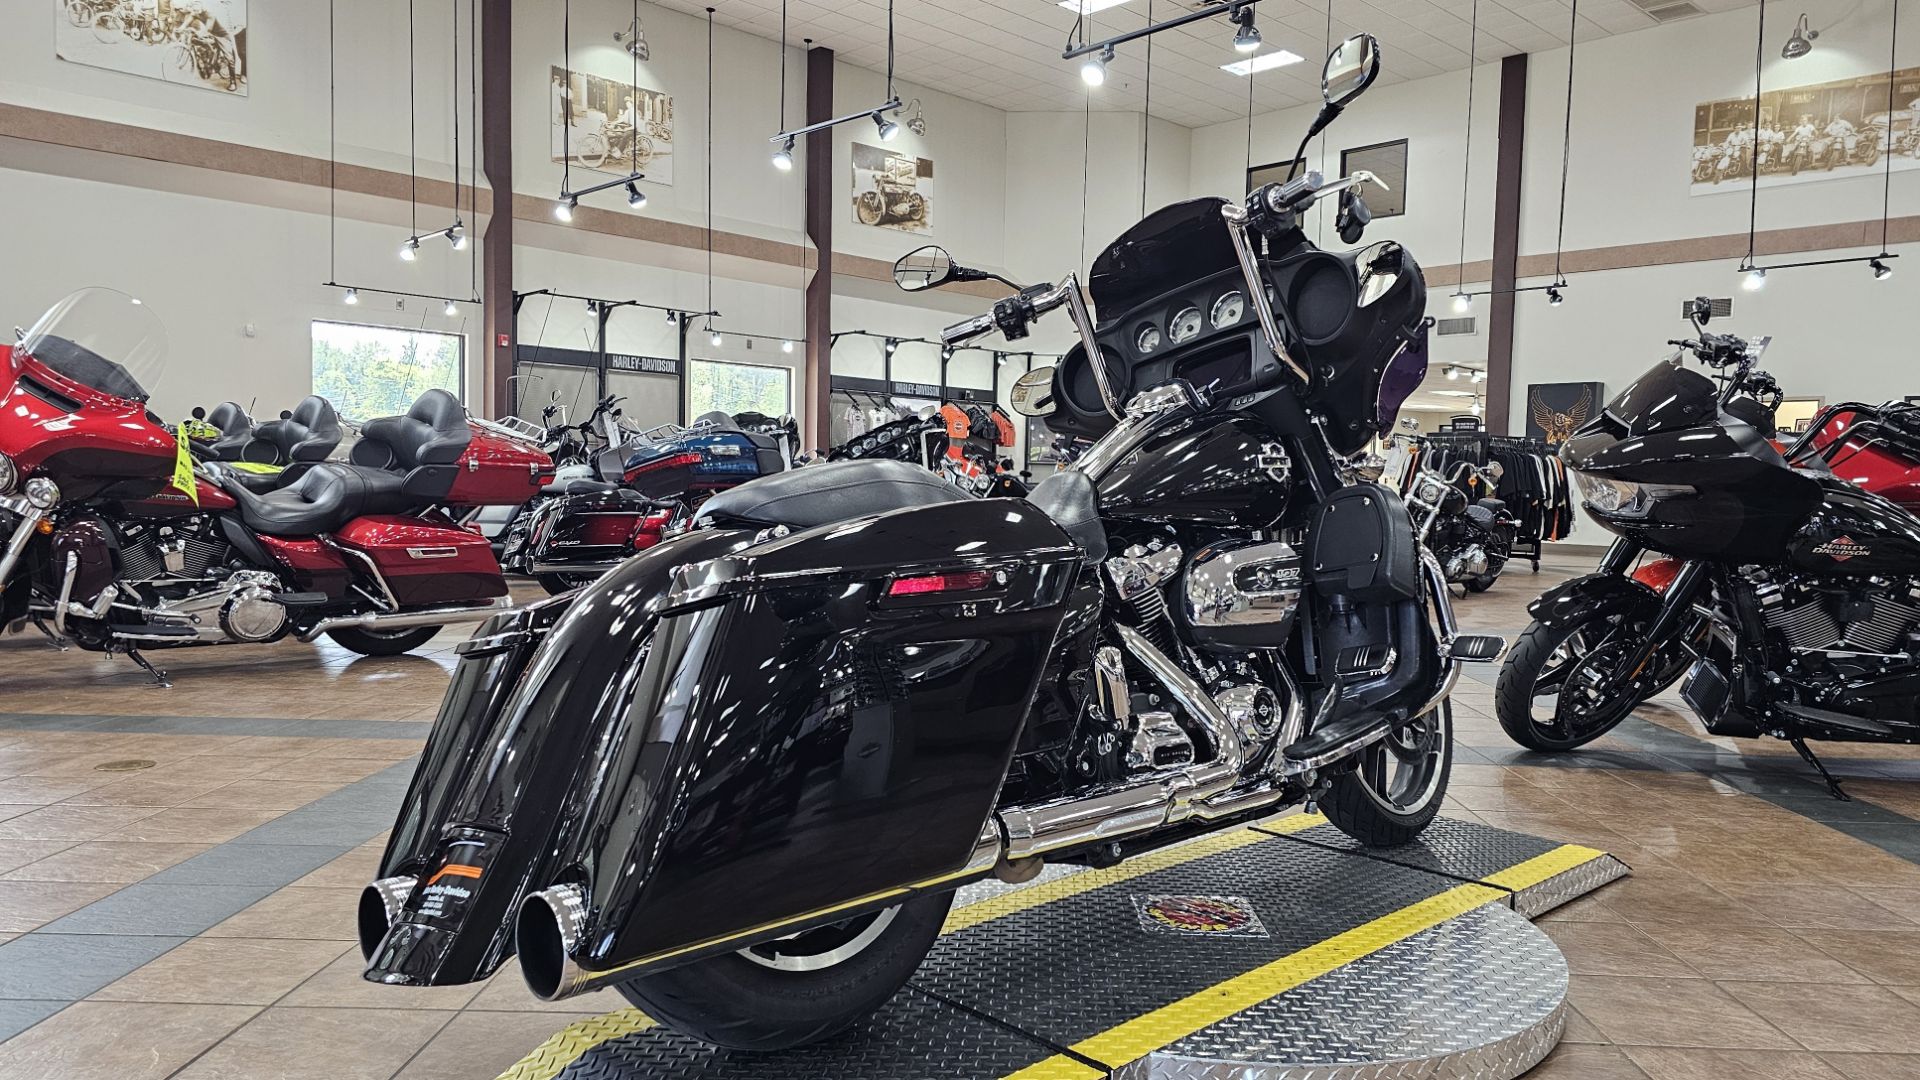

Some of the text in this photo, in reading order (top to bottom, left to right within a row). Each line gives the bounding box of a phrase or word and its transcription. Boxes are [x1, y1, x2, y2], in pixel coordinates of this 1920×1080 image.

[612, 355, 676, 373] HARLEY-DAVIDSON
[895, 382, 940, 397] HARLEY-DAVIDSON
[1812, 547, 1871, 556] DAVIDSON
